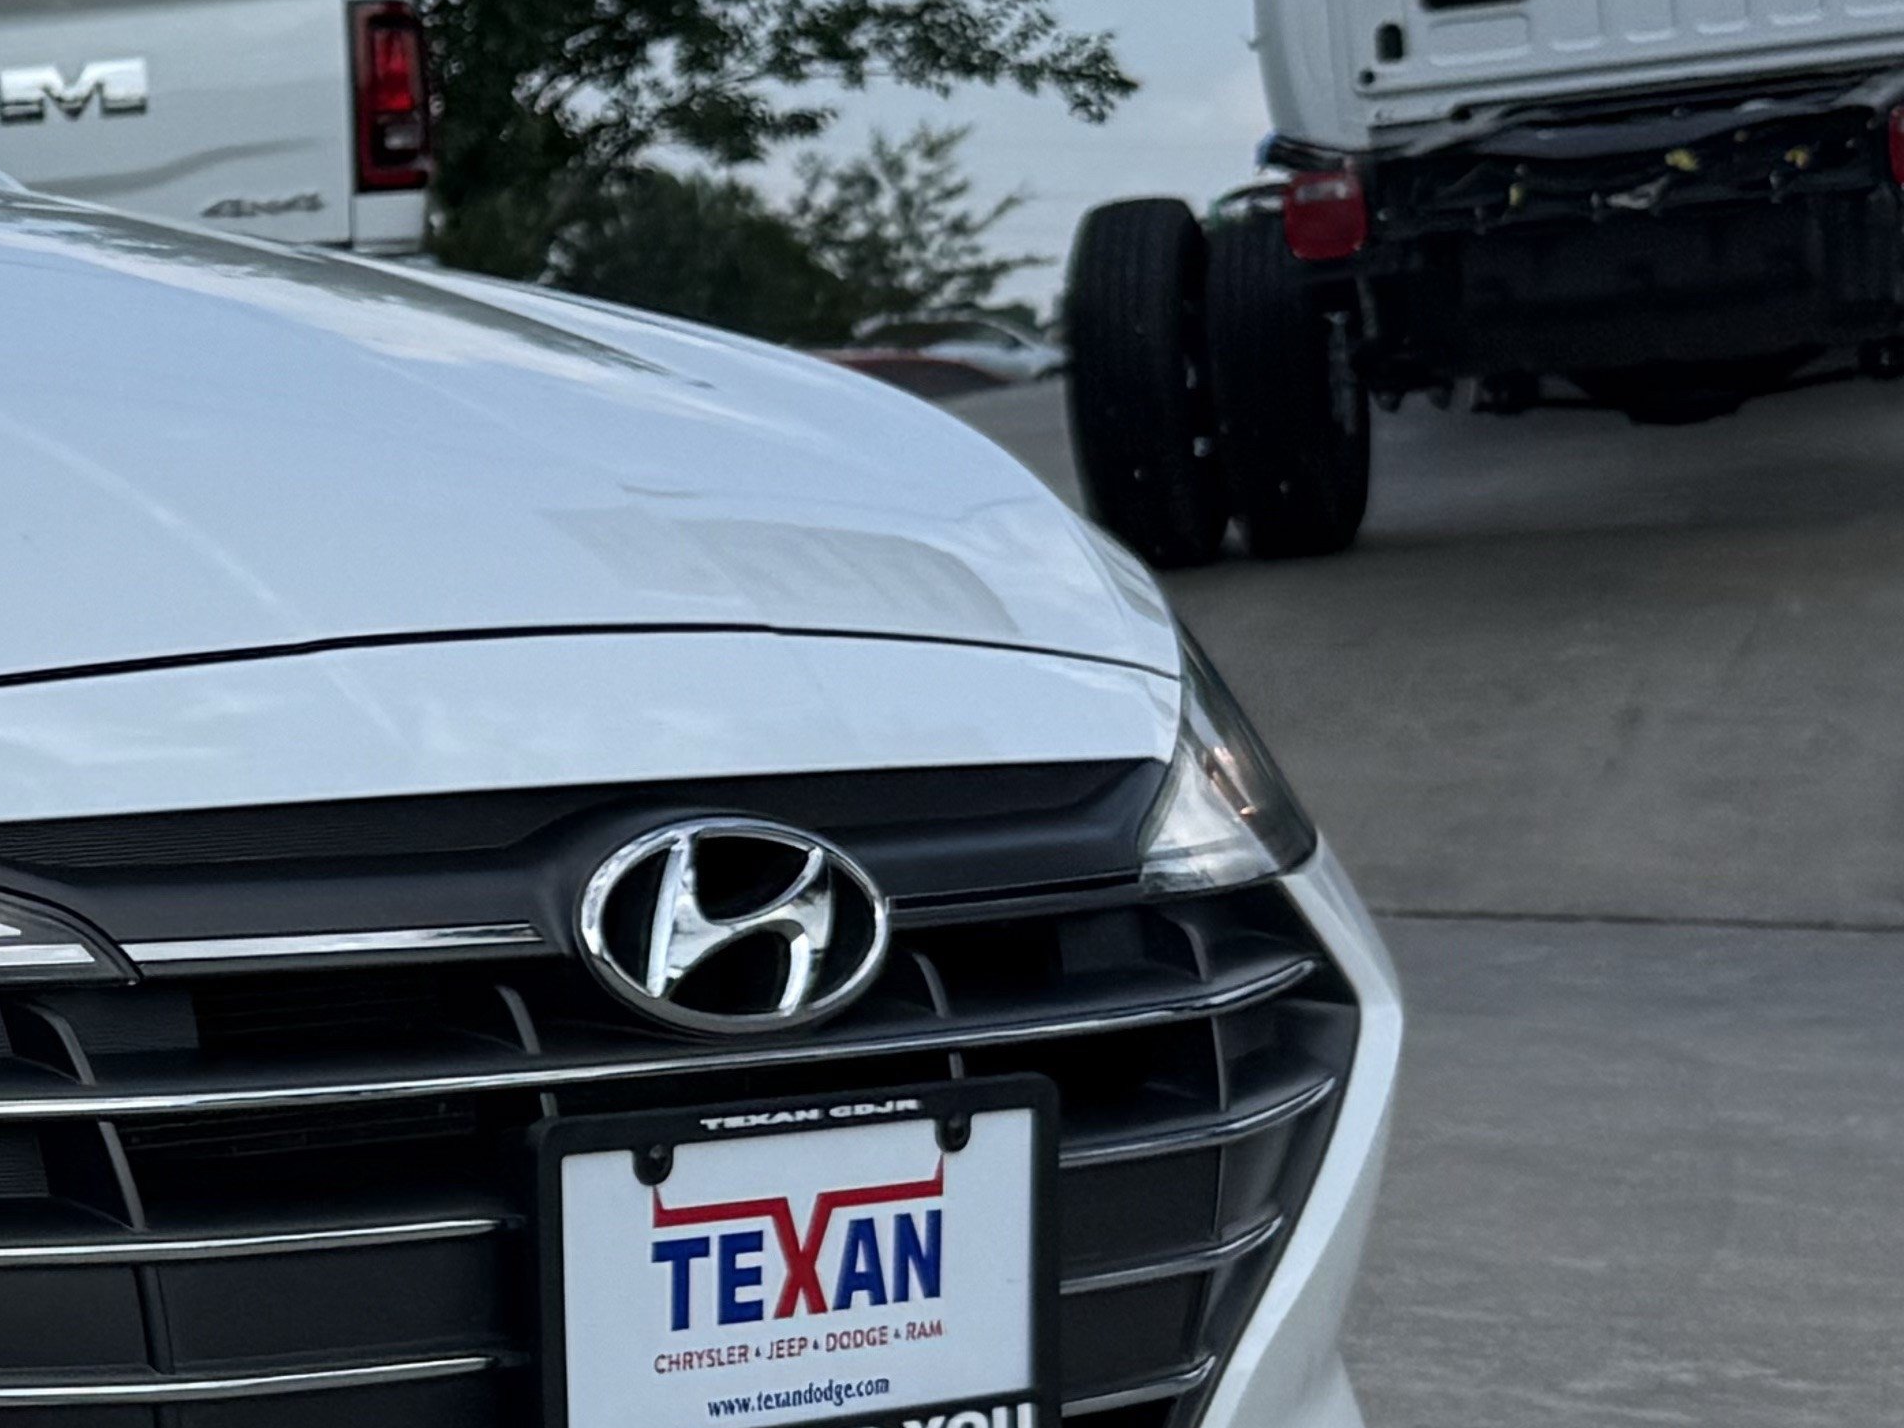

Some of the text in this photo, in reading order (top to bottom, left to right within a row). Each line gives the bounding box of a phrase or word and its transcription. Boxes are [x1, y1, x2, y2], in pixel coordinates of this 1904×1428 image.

[699, 1108, 824, 1131] TEXAN
[651, 1156, 944, 1332] TEXAN
[653, 1319, 943, 1375] CHRYSLER JEEP DODGE RAM
[707, 1376, 890, 1418] www.texandodge.com
